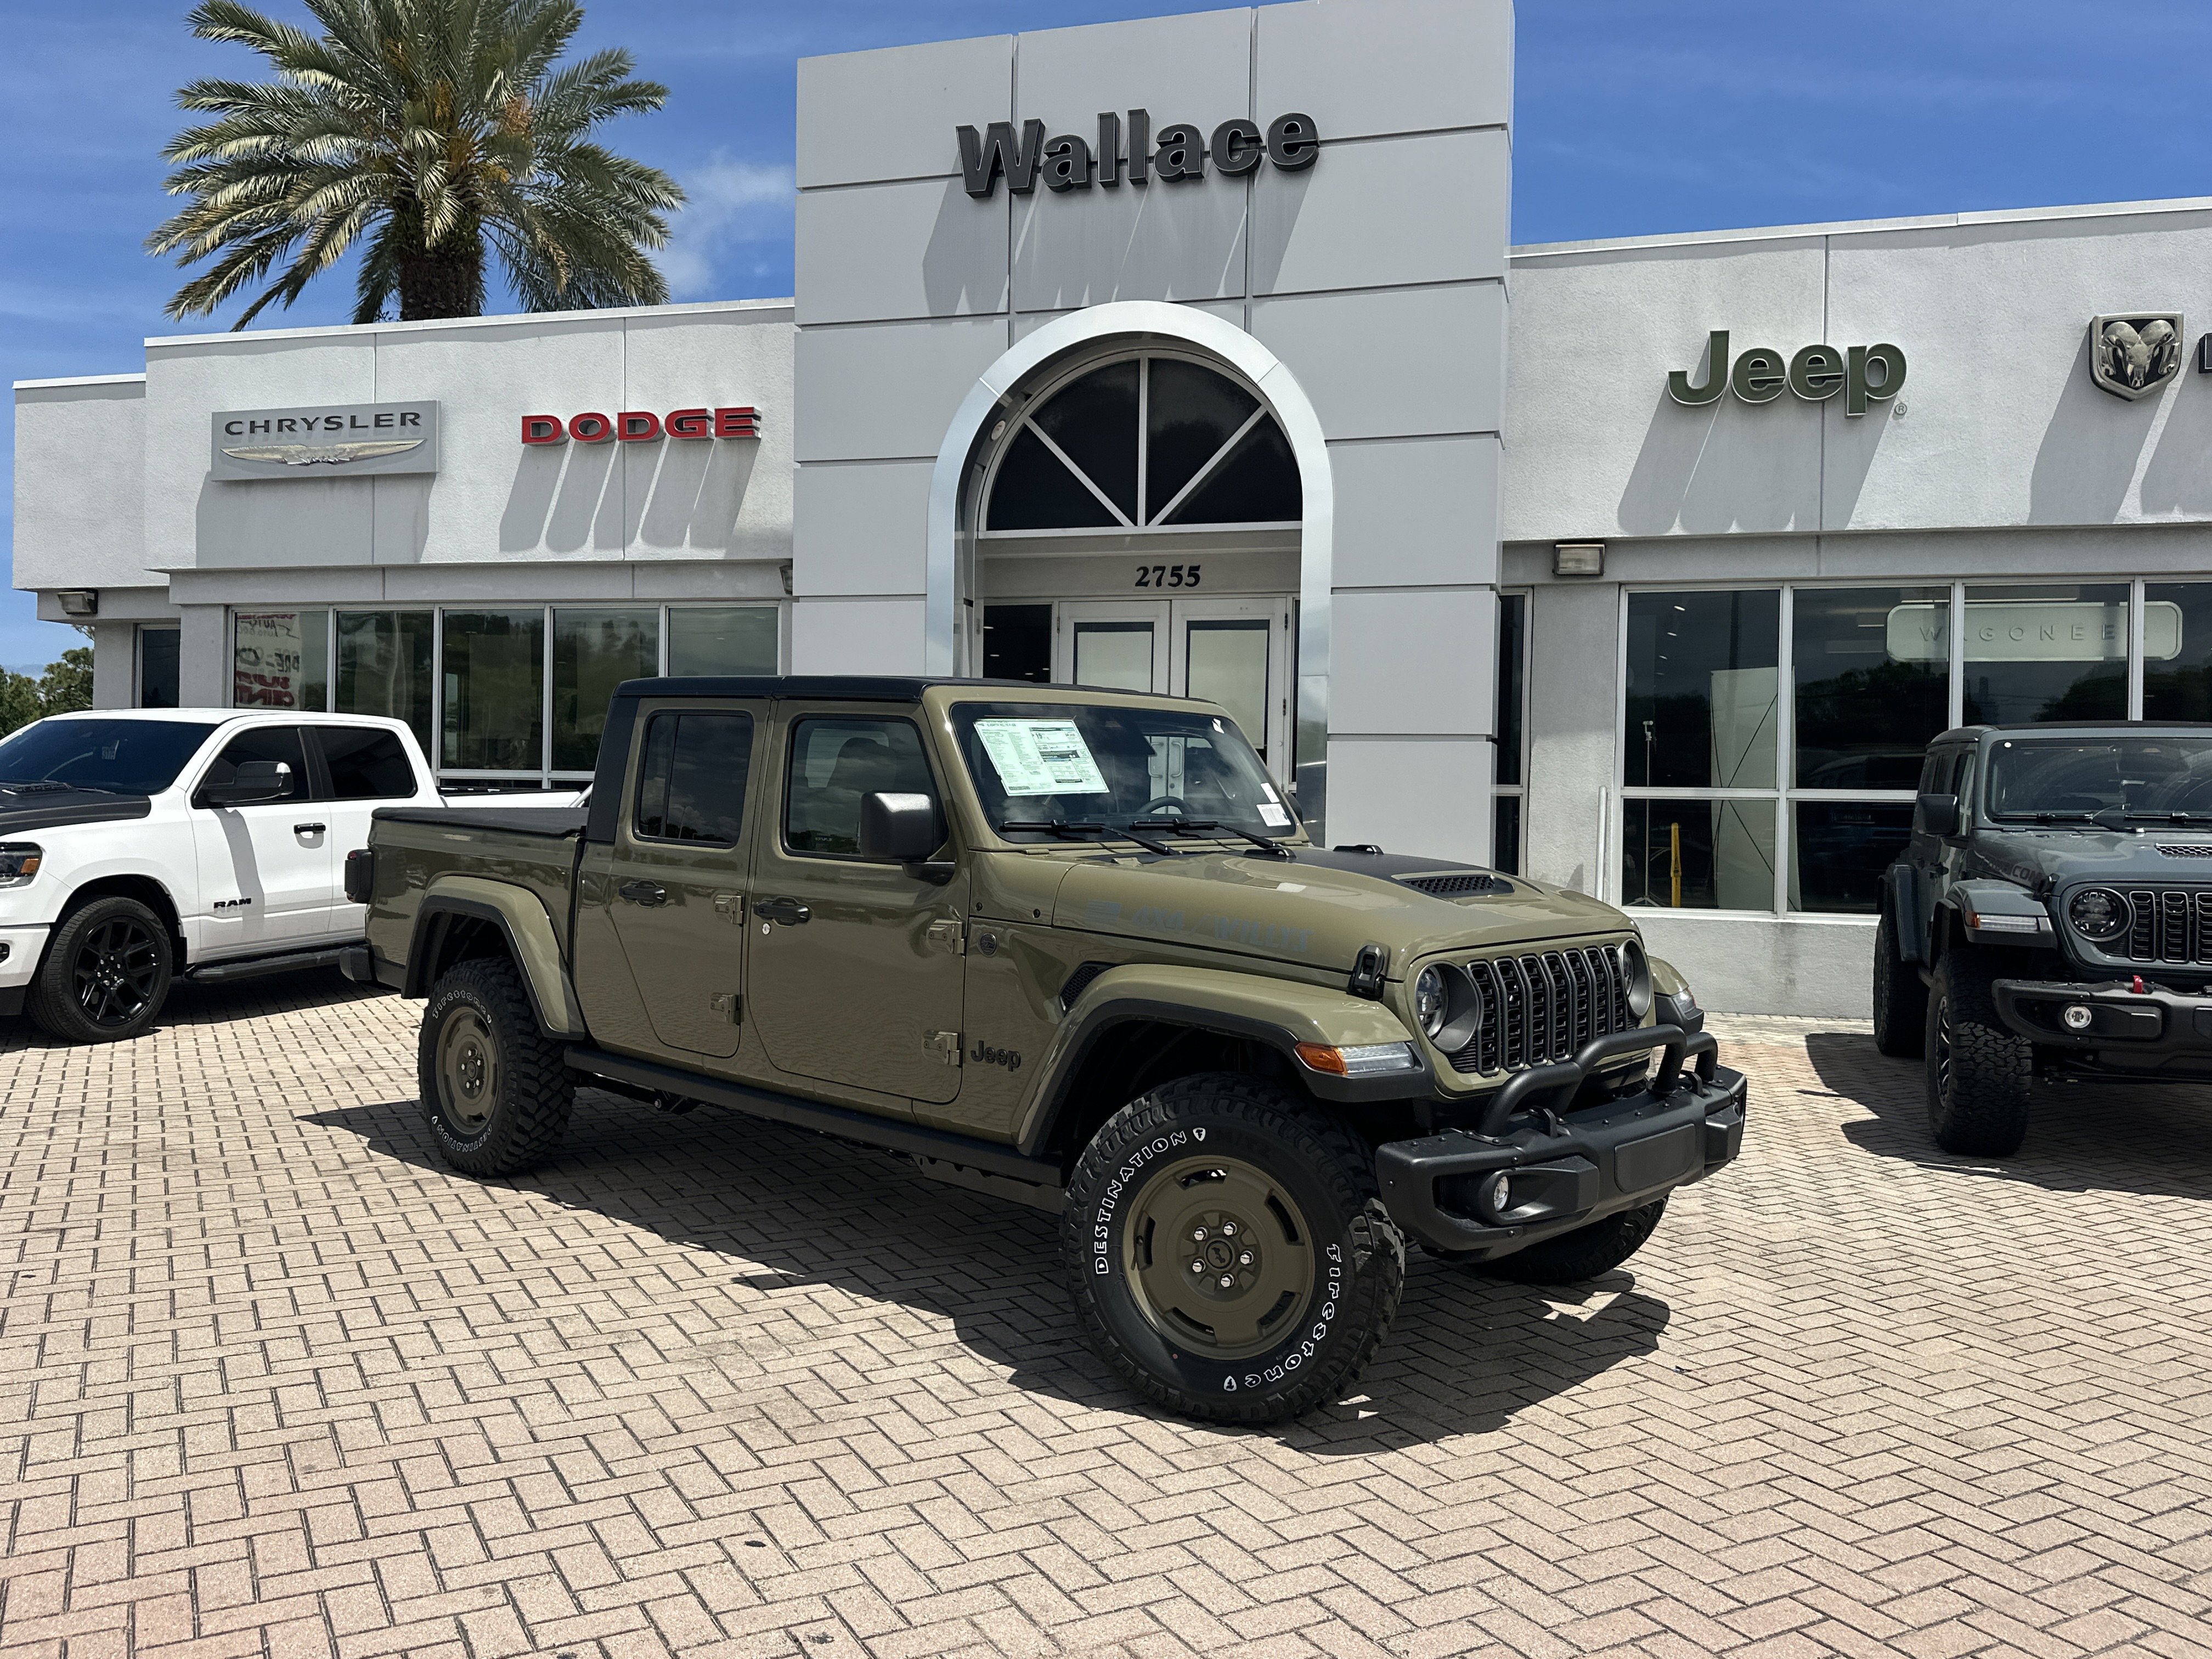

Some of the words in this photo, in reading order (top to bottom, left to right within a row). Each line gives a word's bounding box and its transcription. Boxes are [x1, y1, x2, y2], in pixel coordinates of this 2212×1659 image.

[955, 109, 1319, 198] Wallace
[1667, 330, 1906, 419] Jeep
[224, 412, 421, 435] CHRYSLER
[521, 407, 760, 445] DODGE
[1135, 565, 1201, 587] 2755
[1919, 623, 2148, 641] WGONEE
[213, 898, 252, 909] RAM
[970, 1040, 1022, 1072] Jeep
[437, 1124, 493, 1152] DESTINATION
[1094, 1131, 1187, 1274] DESTINATION
